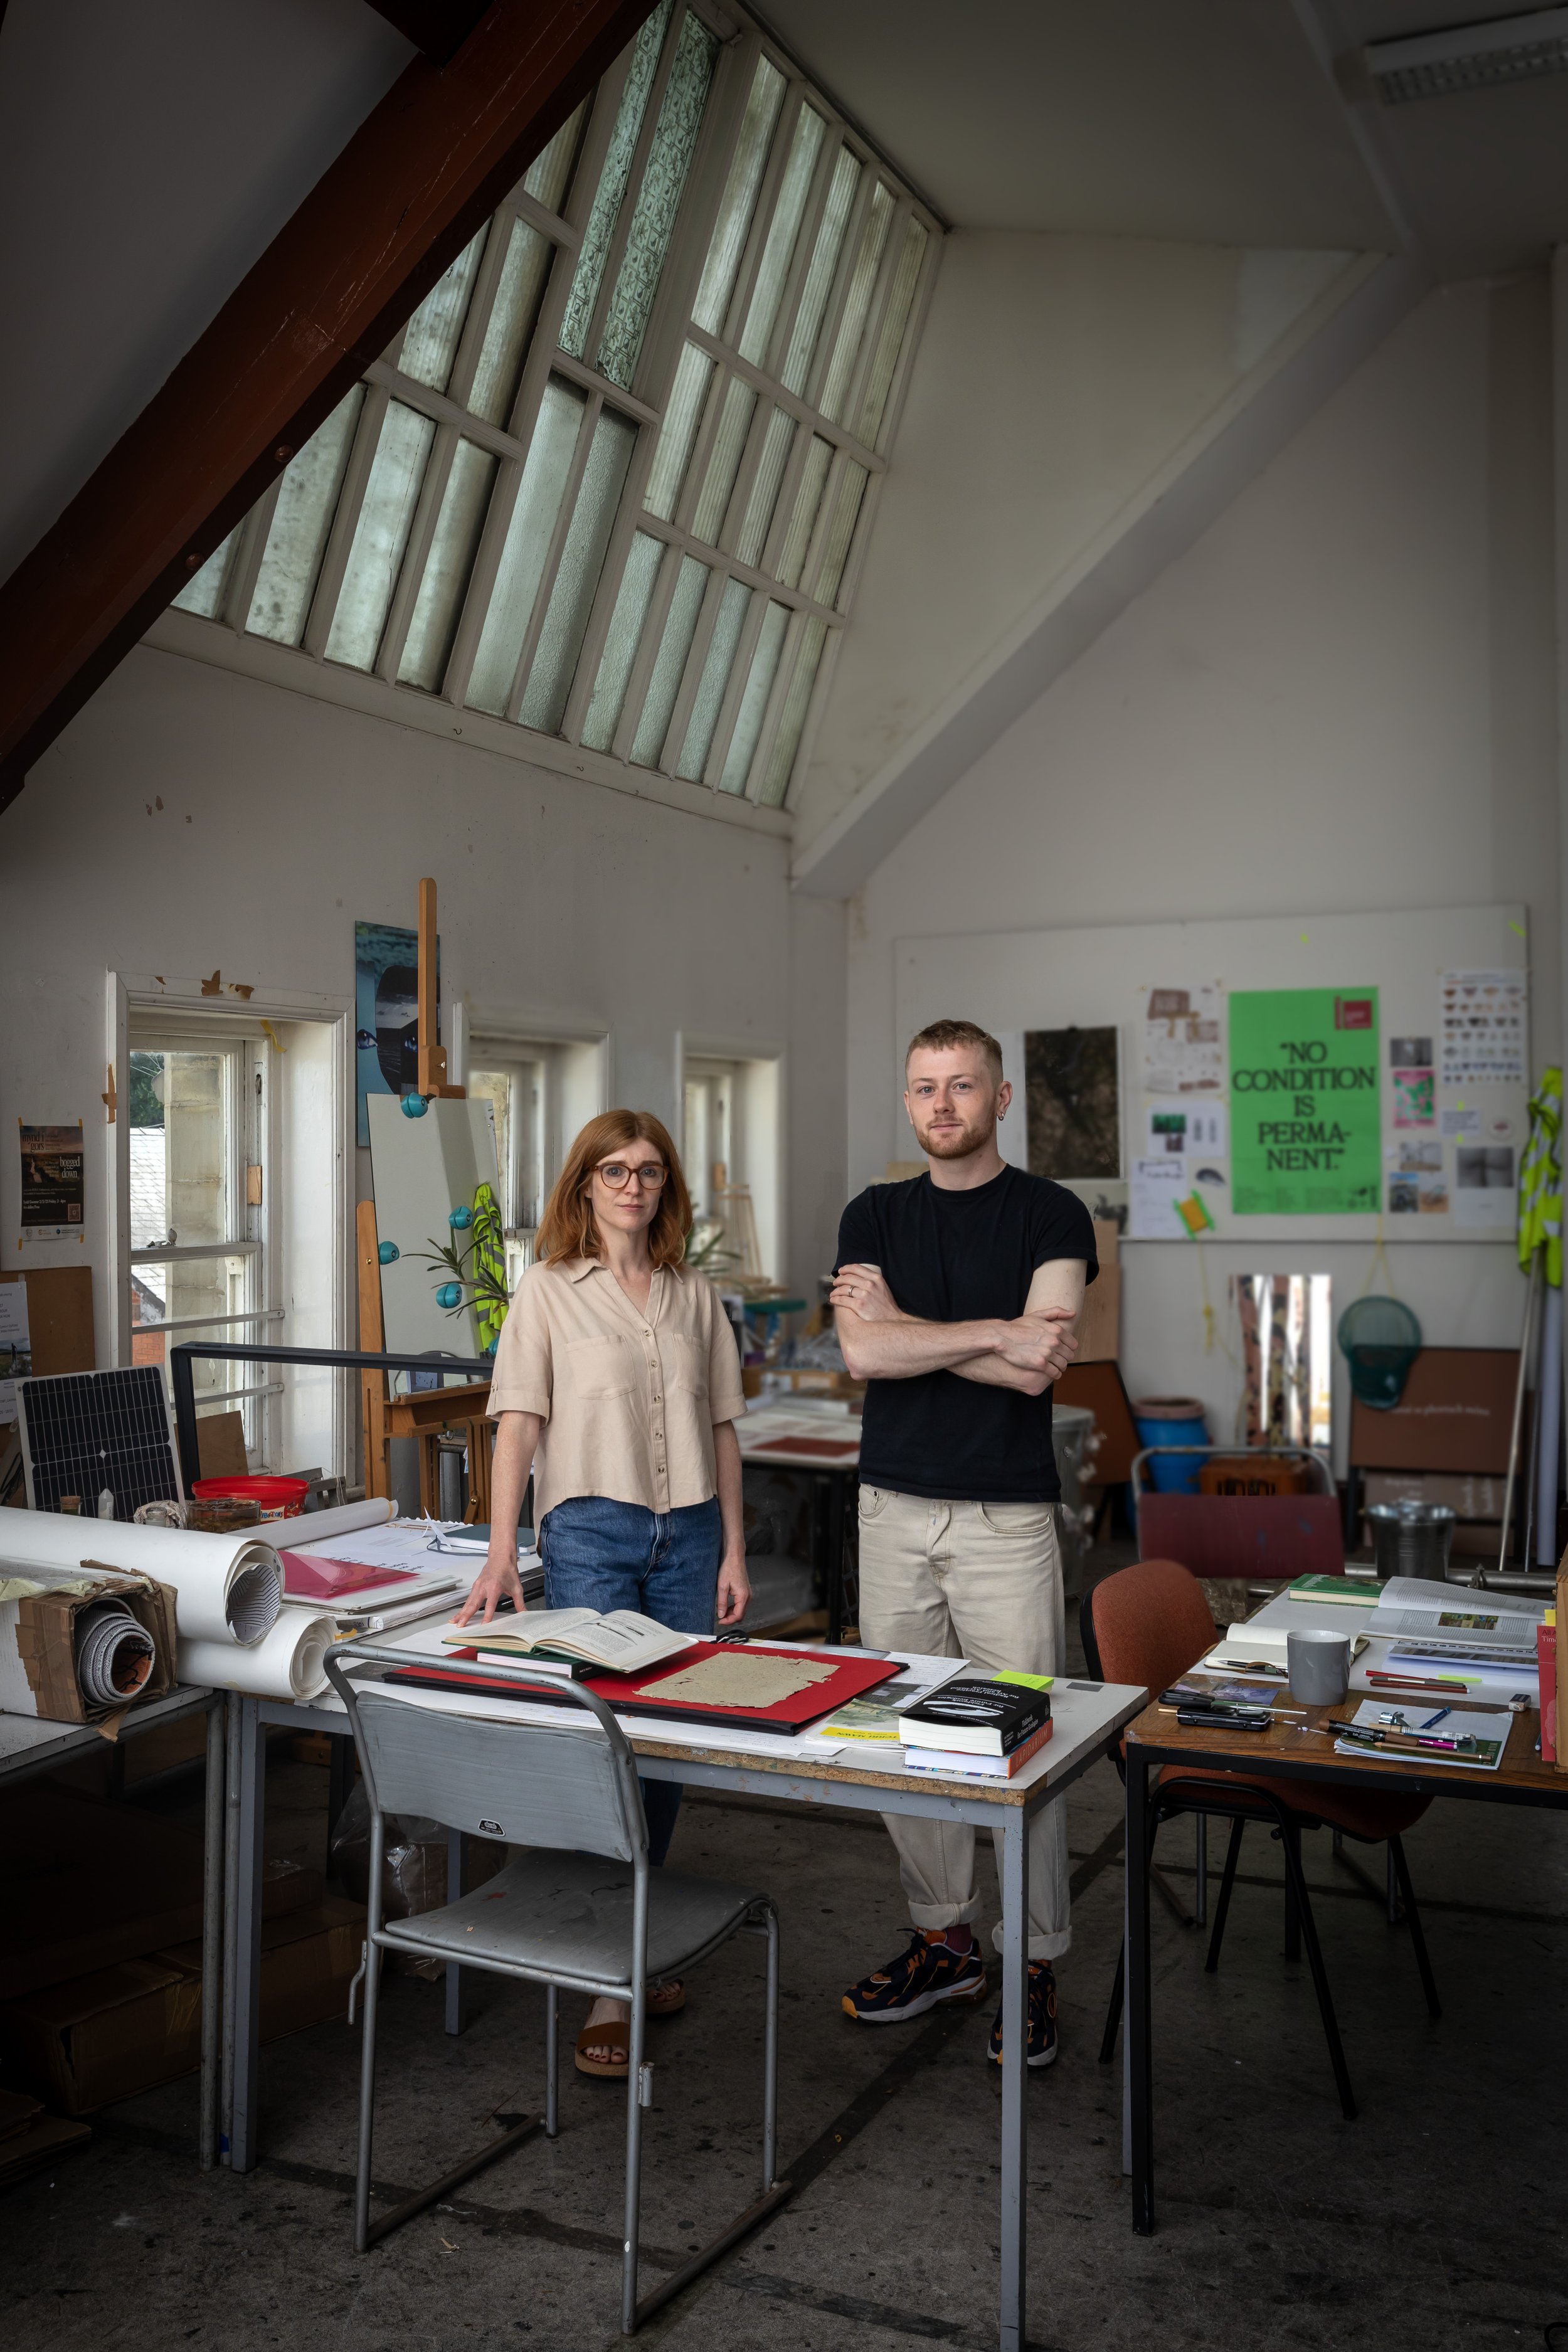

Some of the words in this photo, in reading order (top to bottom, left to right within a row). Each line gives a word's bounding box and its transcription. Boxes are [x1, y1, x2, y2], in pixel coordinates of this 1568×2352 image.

[1232, 1066, 1375, 1093] CONDITION
[1293, 1095, 1315, 1118] IS
[1258, 1121, 1352, 1145] PERMA-
[30, 1142, 45, 1153] gors
[60, 1156, 80, 1170] bogged
[61, 1167, 78, 1179] down
[1016, 1728, 1047, 1767] LAPIDARIUM
